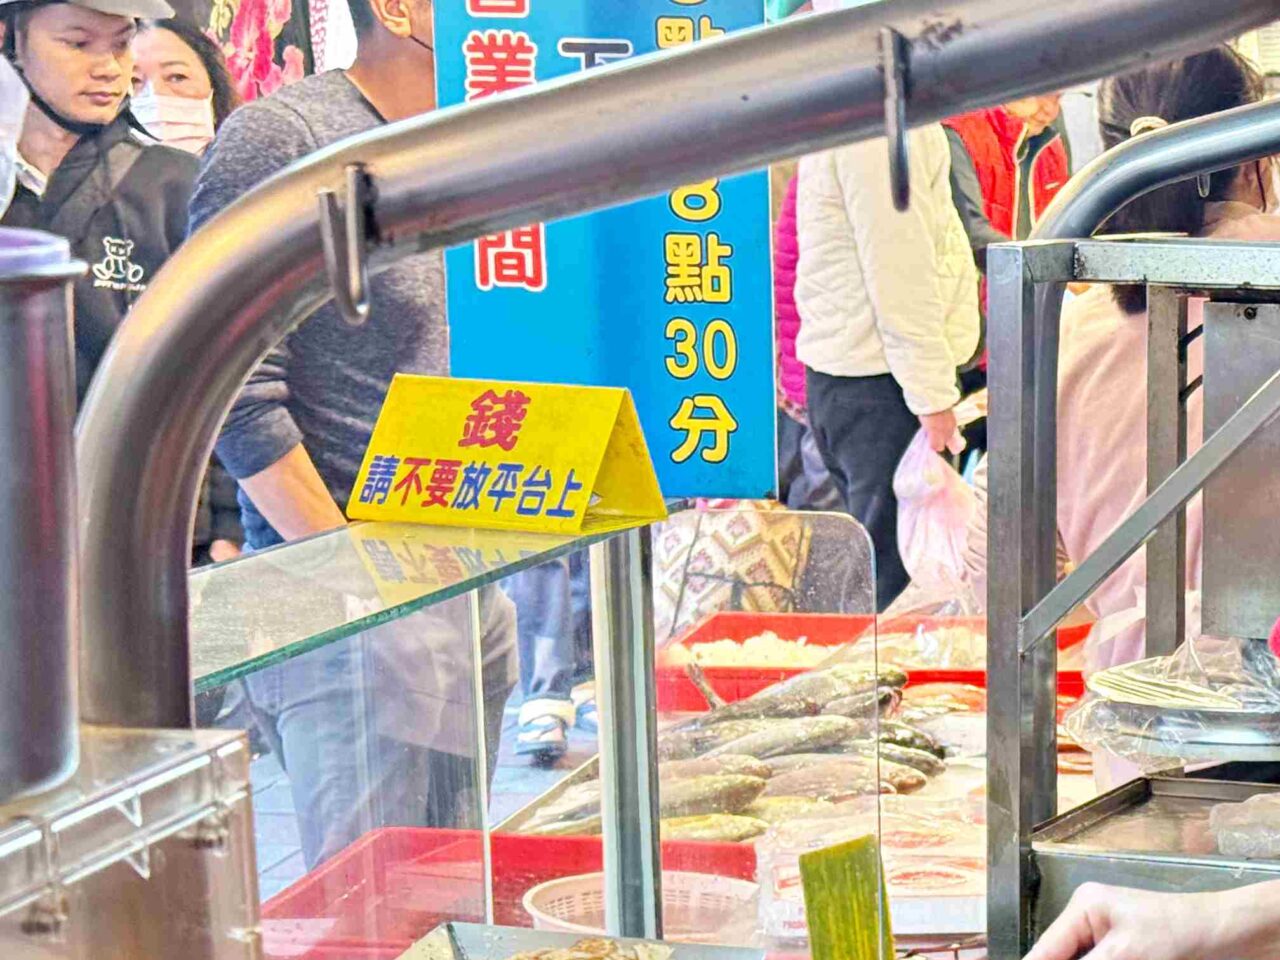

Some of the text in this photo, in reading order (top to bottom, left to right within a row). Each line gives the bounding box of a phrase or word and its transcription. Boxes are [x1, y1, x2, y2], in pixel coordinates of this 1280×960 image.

[458, 388, 532, 451] 錢
[358, 454, 583, 518] 請不要放平台上
